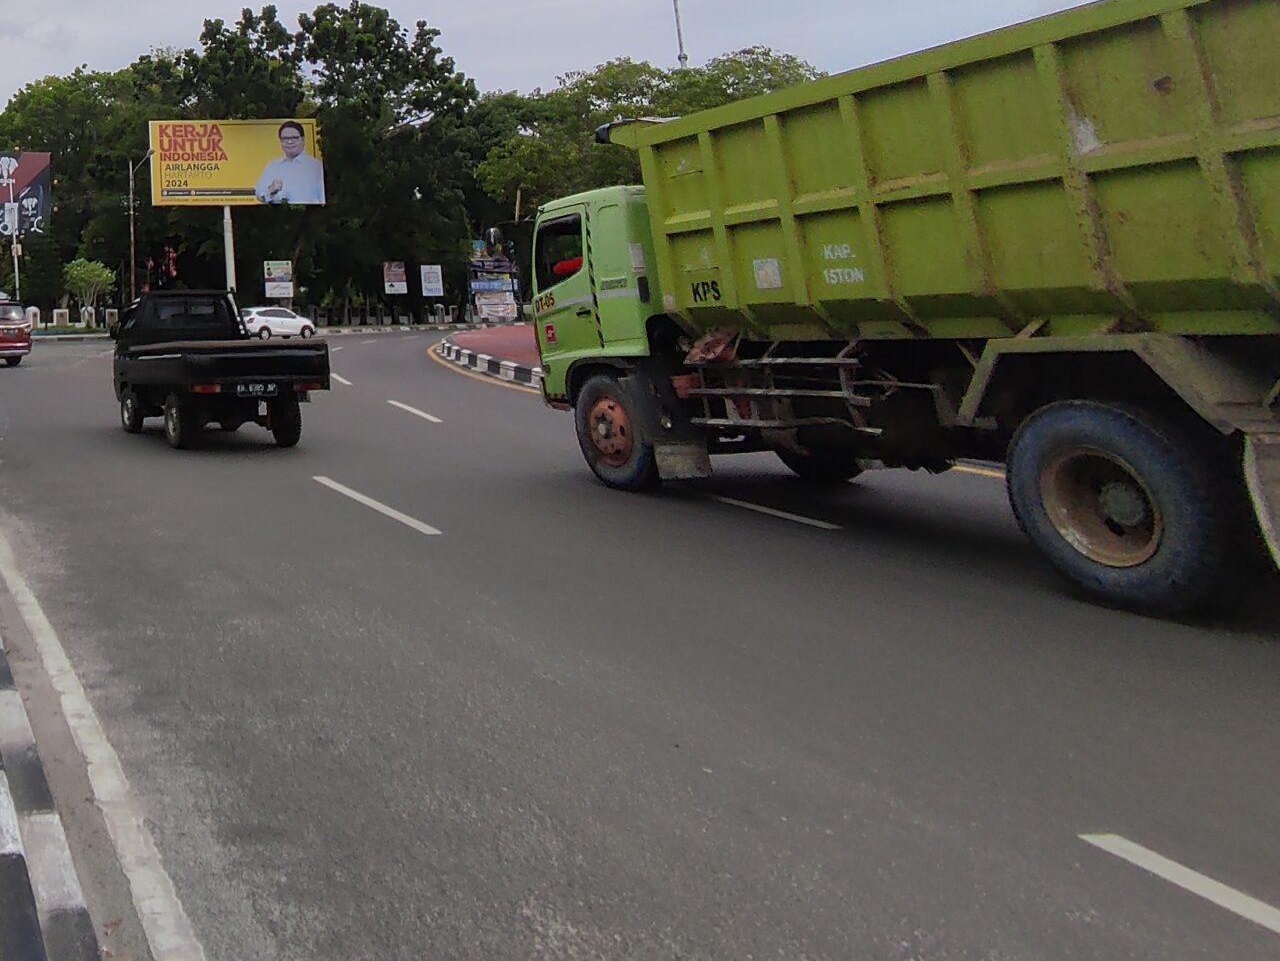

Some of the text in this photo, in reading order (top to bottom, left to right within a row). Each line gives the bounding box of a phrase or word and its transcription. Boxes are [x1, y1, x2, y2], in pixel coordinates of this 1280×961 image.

[158, 124, 223, 138] KERJA
[160, 139, 224, 152] UNTUK
[160, 152, 228, 161] INDONESIA
[165, 163, 220, 171] AIRLANGGA
[165, 171, 212, 179] HARTARTO
[691, 280, 722, 303] KPS
